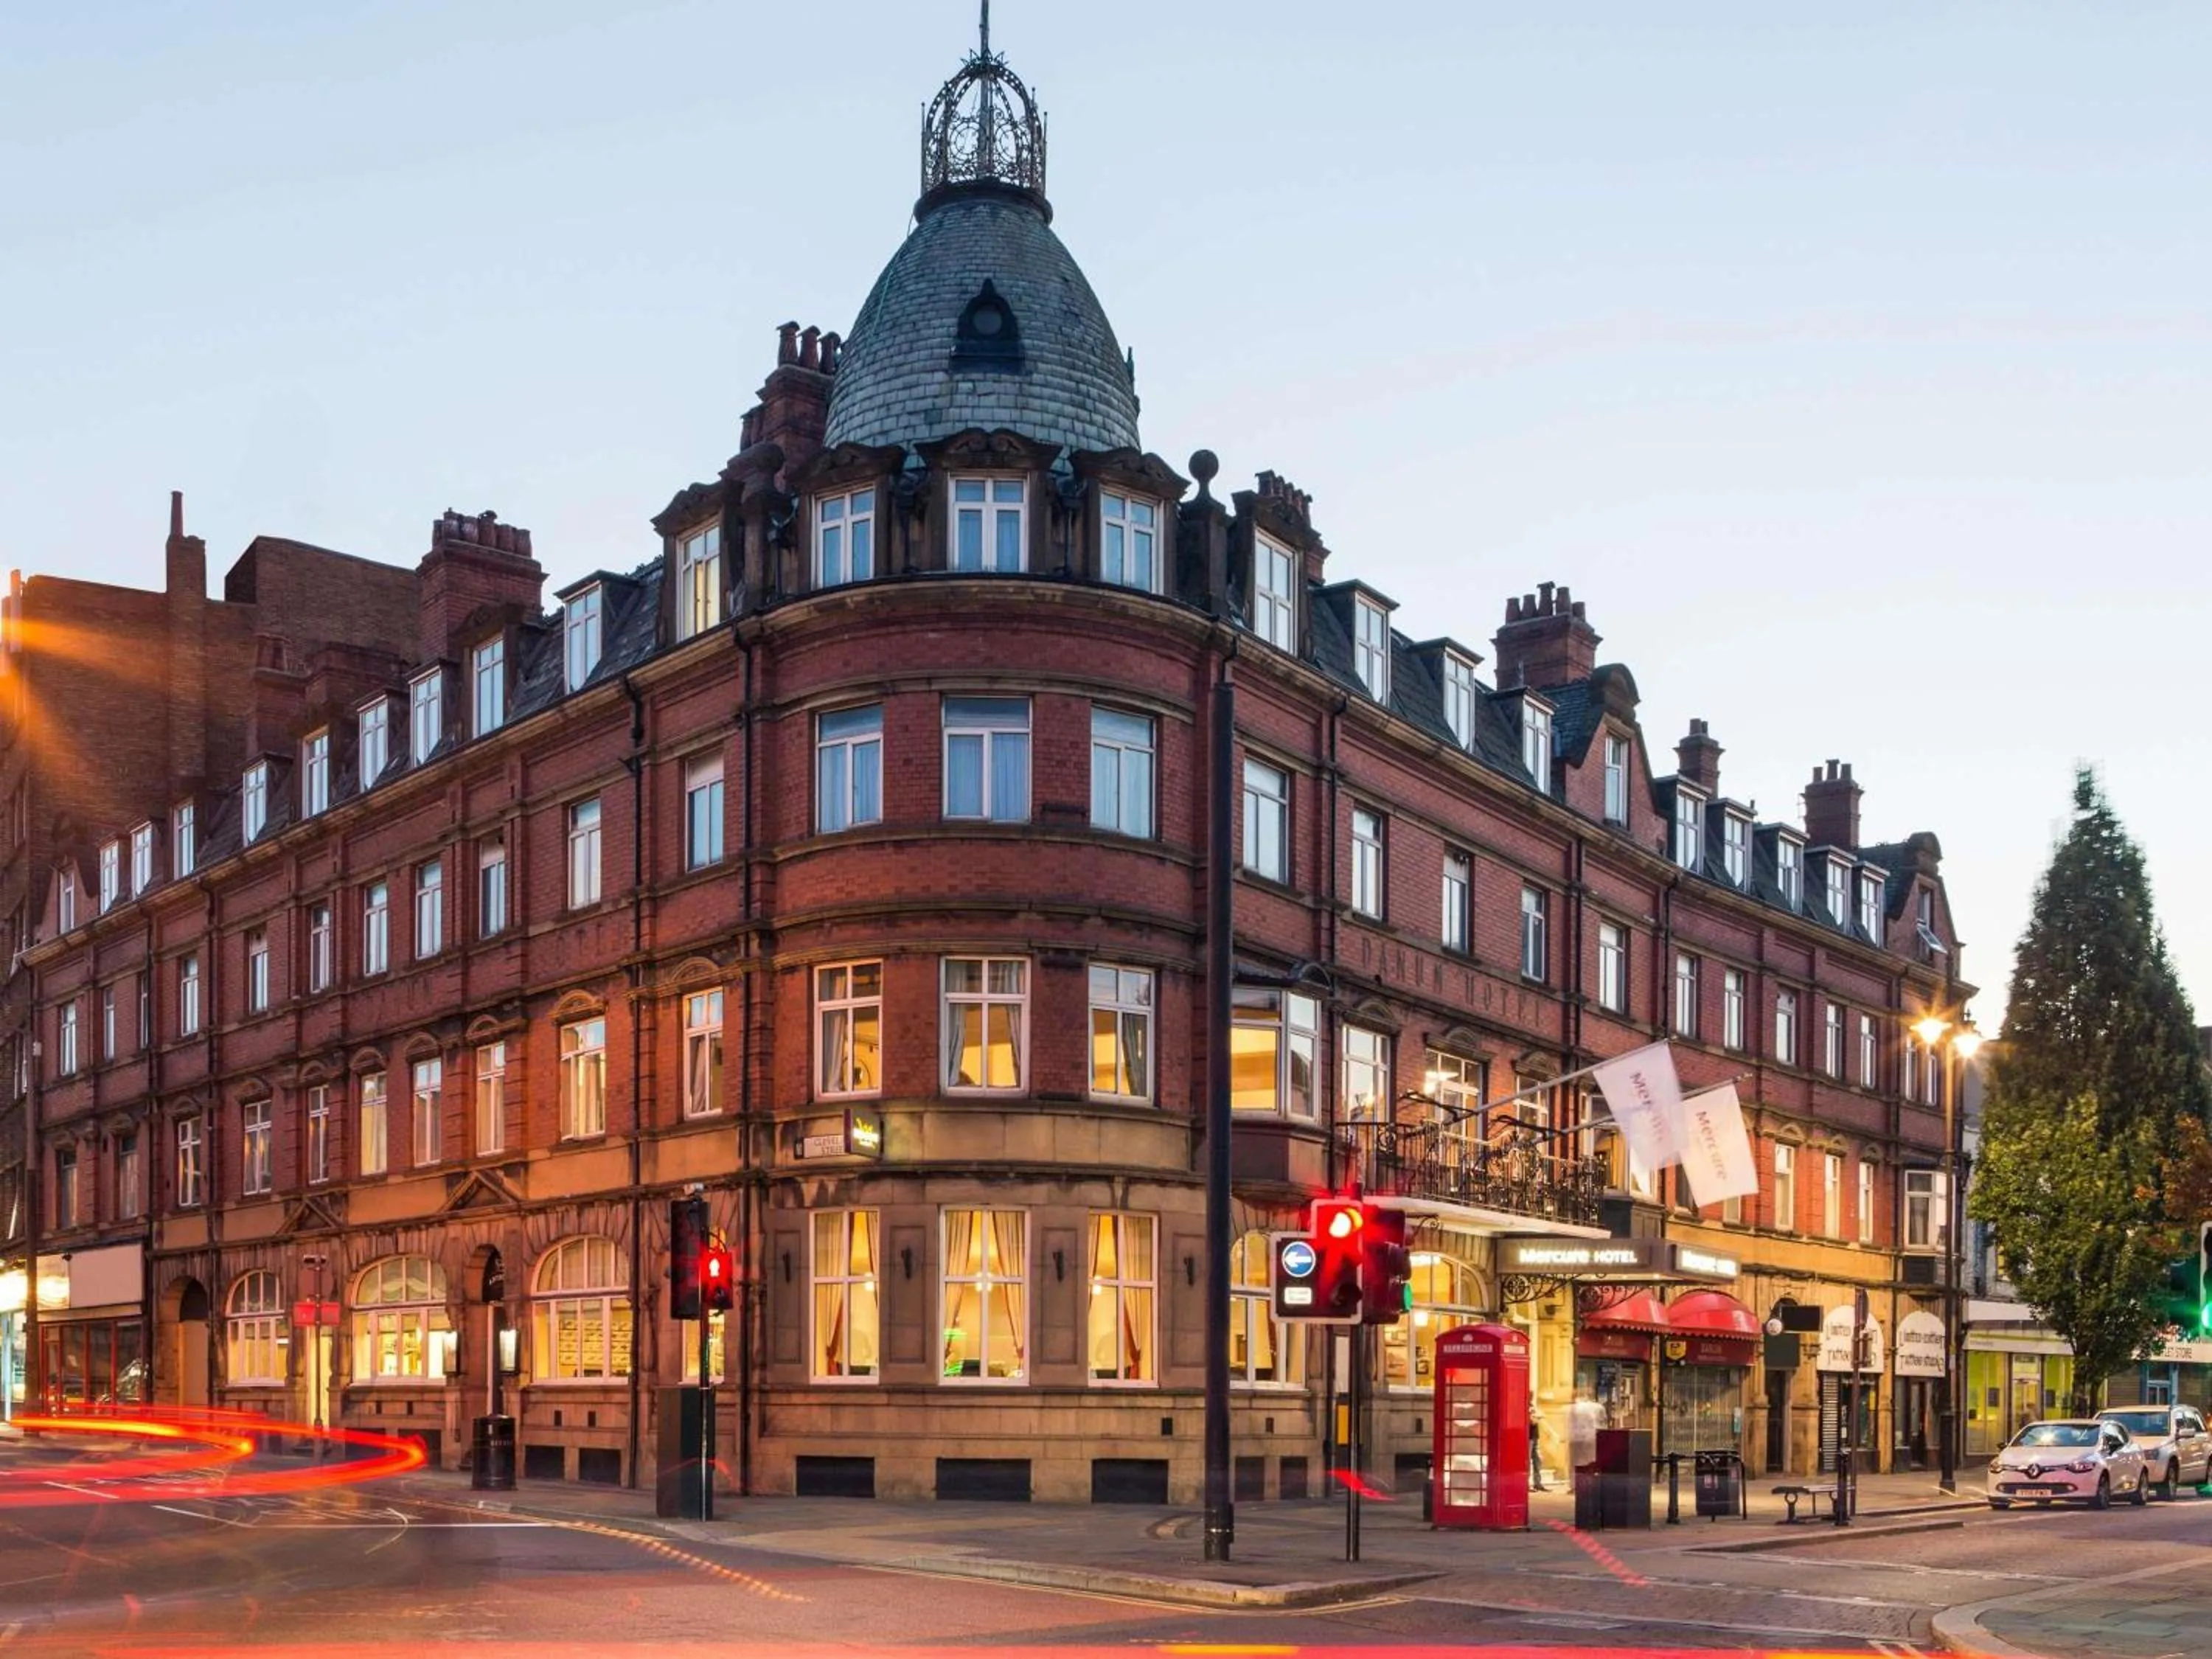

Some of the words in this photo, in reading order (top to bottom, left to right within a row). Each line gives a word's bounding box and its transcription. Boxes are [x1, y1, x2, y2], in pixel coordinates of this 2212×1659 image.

[1362, 937, 1443, 995] DANUM
[1465, 973, 1540, 1028] HOTEL
[1696, 1110, 1728, 1181] Mercure
[1594, 1250, 1638, 1263] HOTEL
